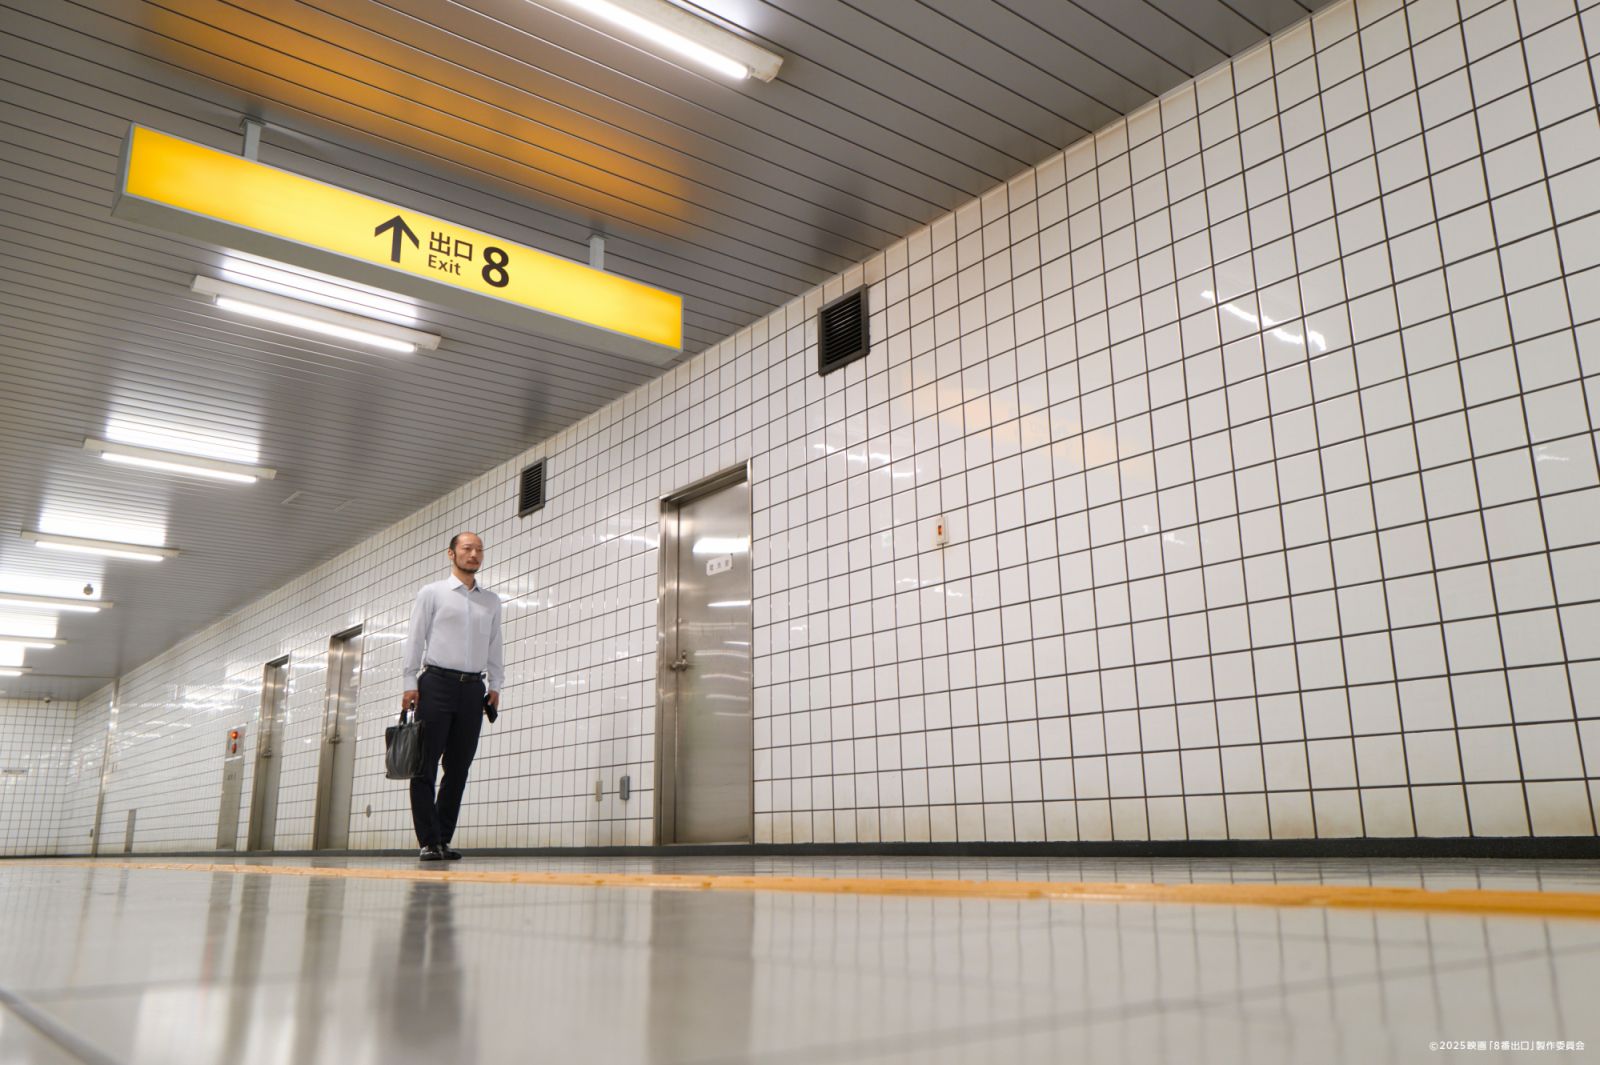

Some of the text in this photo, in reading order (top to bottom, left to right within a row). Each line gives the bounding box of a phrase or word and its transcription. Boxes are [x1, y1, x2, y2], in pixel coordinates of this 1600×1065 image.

[428, 254, 461, 276] Exit
[429, 231, 509, 288] 出口 8
